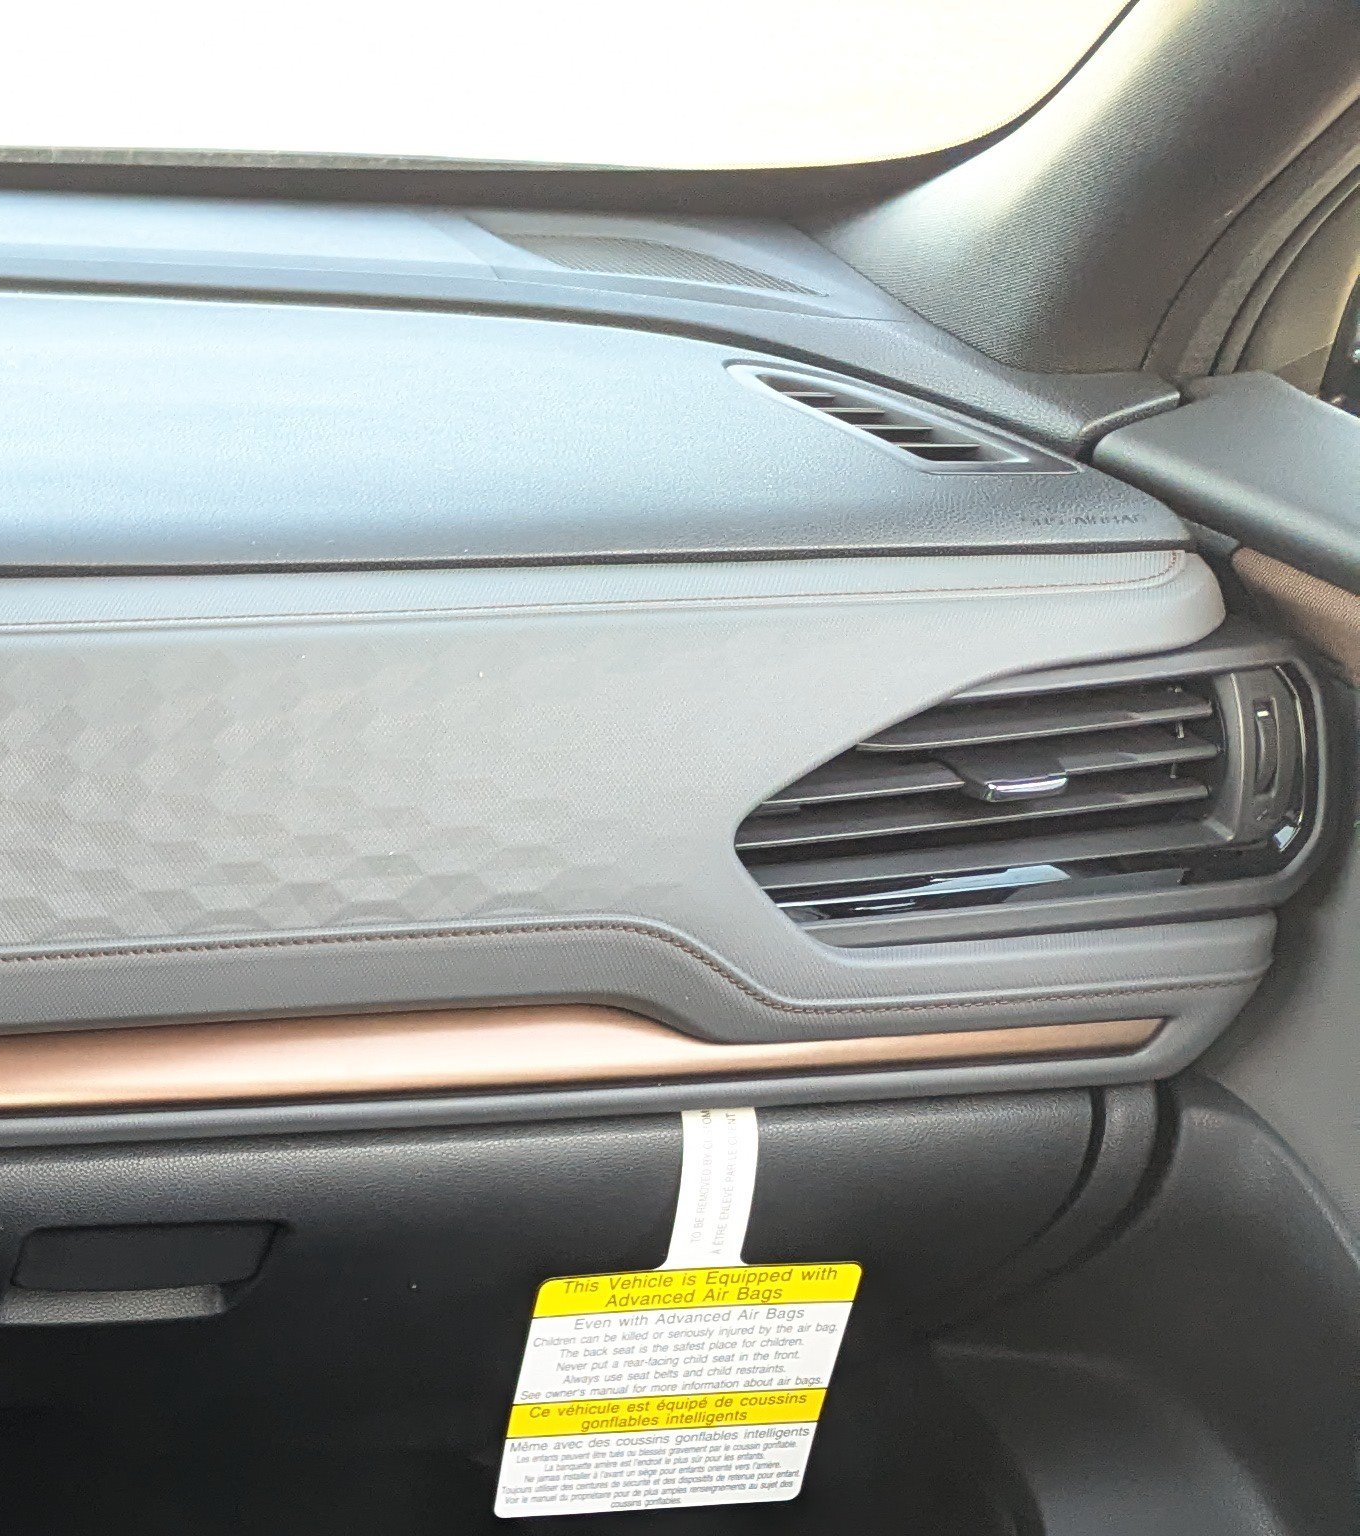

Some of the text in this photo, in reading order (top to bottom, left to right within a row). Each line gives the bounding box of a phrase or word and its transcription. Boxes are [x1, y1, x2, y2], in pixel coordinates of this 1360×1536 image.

[564, 1267, 838, 1293] This Vehicle is Equipped with
[606, 1286, 783, 1307] Advanced Air Bags
[574, 1308, 805, 1330] Even with Advanced Air Bags
[533, 1323, 837, 1347] Children can be killed or seriously injured by the air bag.
[560, 1337, 804, 1358] The back seat is the safest place for children.
[556, 1361, 586, 1372] Never
[591, 1359, 608, 1371] put
[684, 1353, 708, 1364] child
[712, 1352, 735, 1362] seat
[739, 1351, 748, 1361] in
[753, 1351, 769, 1360] the
[774, 1349, 800, 1359] front.
[562, 1364, 786, 1385] Always use seat belts and child restraints.
[521, 1390, 541, 1400] See
[590, 1385, 629, 1396] manual
[633, 1383, 646, 1393] for
[651, 1383, 677, 1392] more
[682, 1378, 739, 1390] information
[743, 1377, 773, 1388] about
[777, 1376, 791, 1386] air
[795, 1375, 823, 1387] bags.
[530, 1393, 807, 1418] Ce véhicule est équipé de coussins
[581, 1410, 748, 1432] gonflables intelligents
[510, 1427, 810, 1453] Même avec des coussins gonflables intelligents
